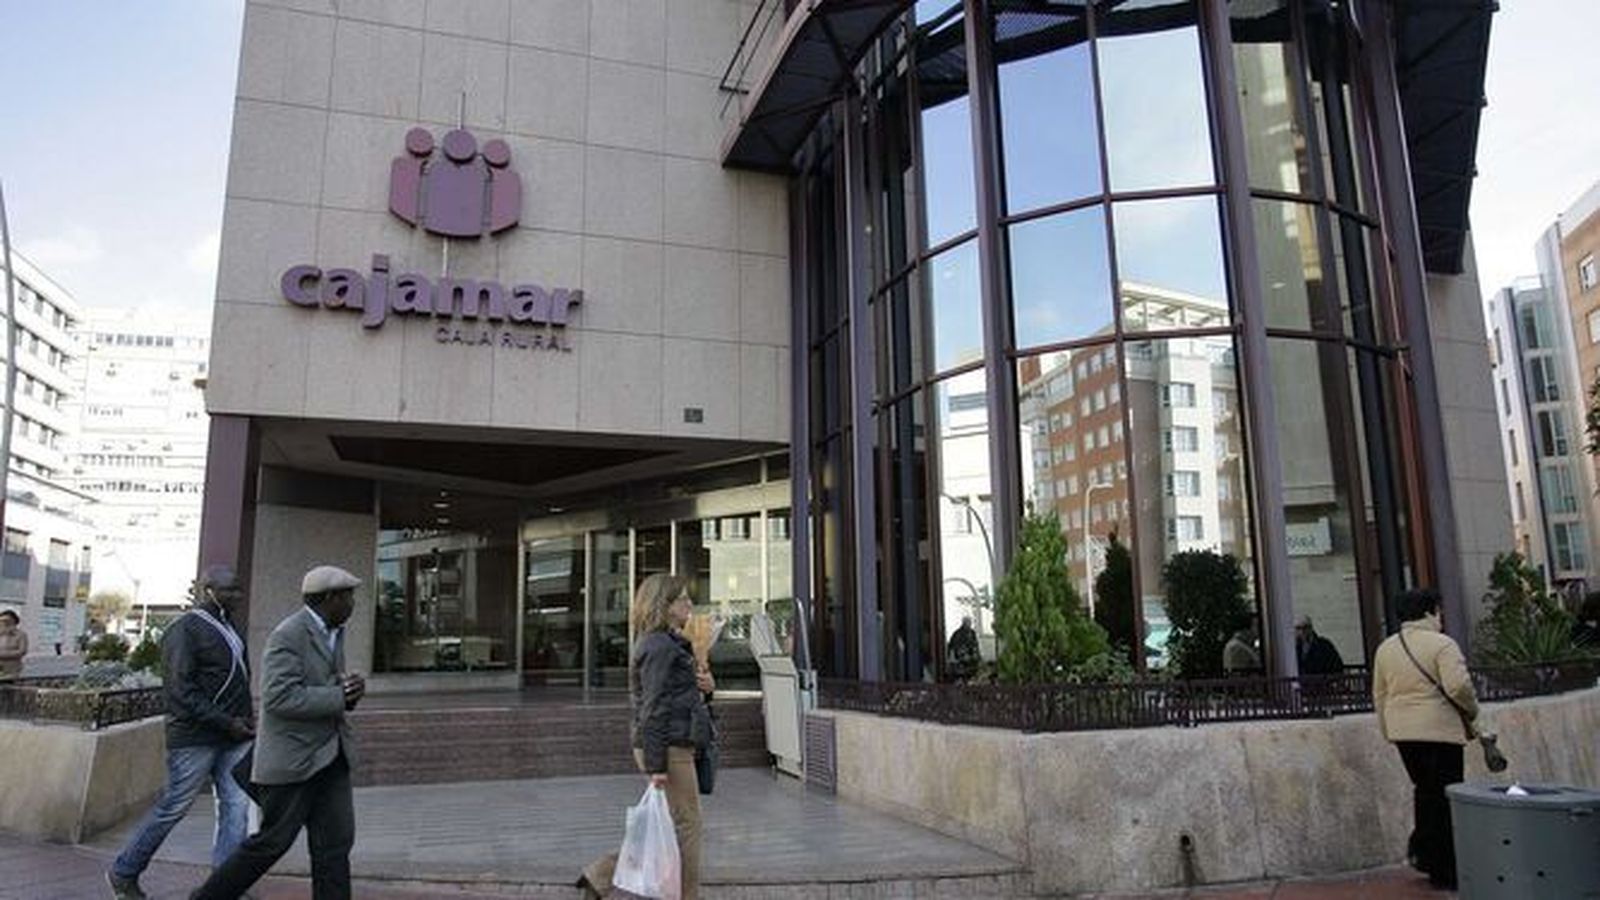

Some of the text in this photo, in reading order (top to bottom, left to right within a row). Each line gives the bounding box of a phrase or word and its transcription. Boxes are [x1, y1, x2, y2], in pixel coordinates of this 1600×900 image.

[281, 253, 584, 330] cajamar
[435, 326, 572, 353] CAJA RURAL
